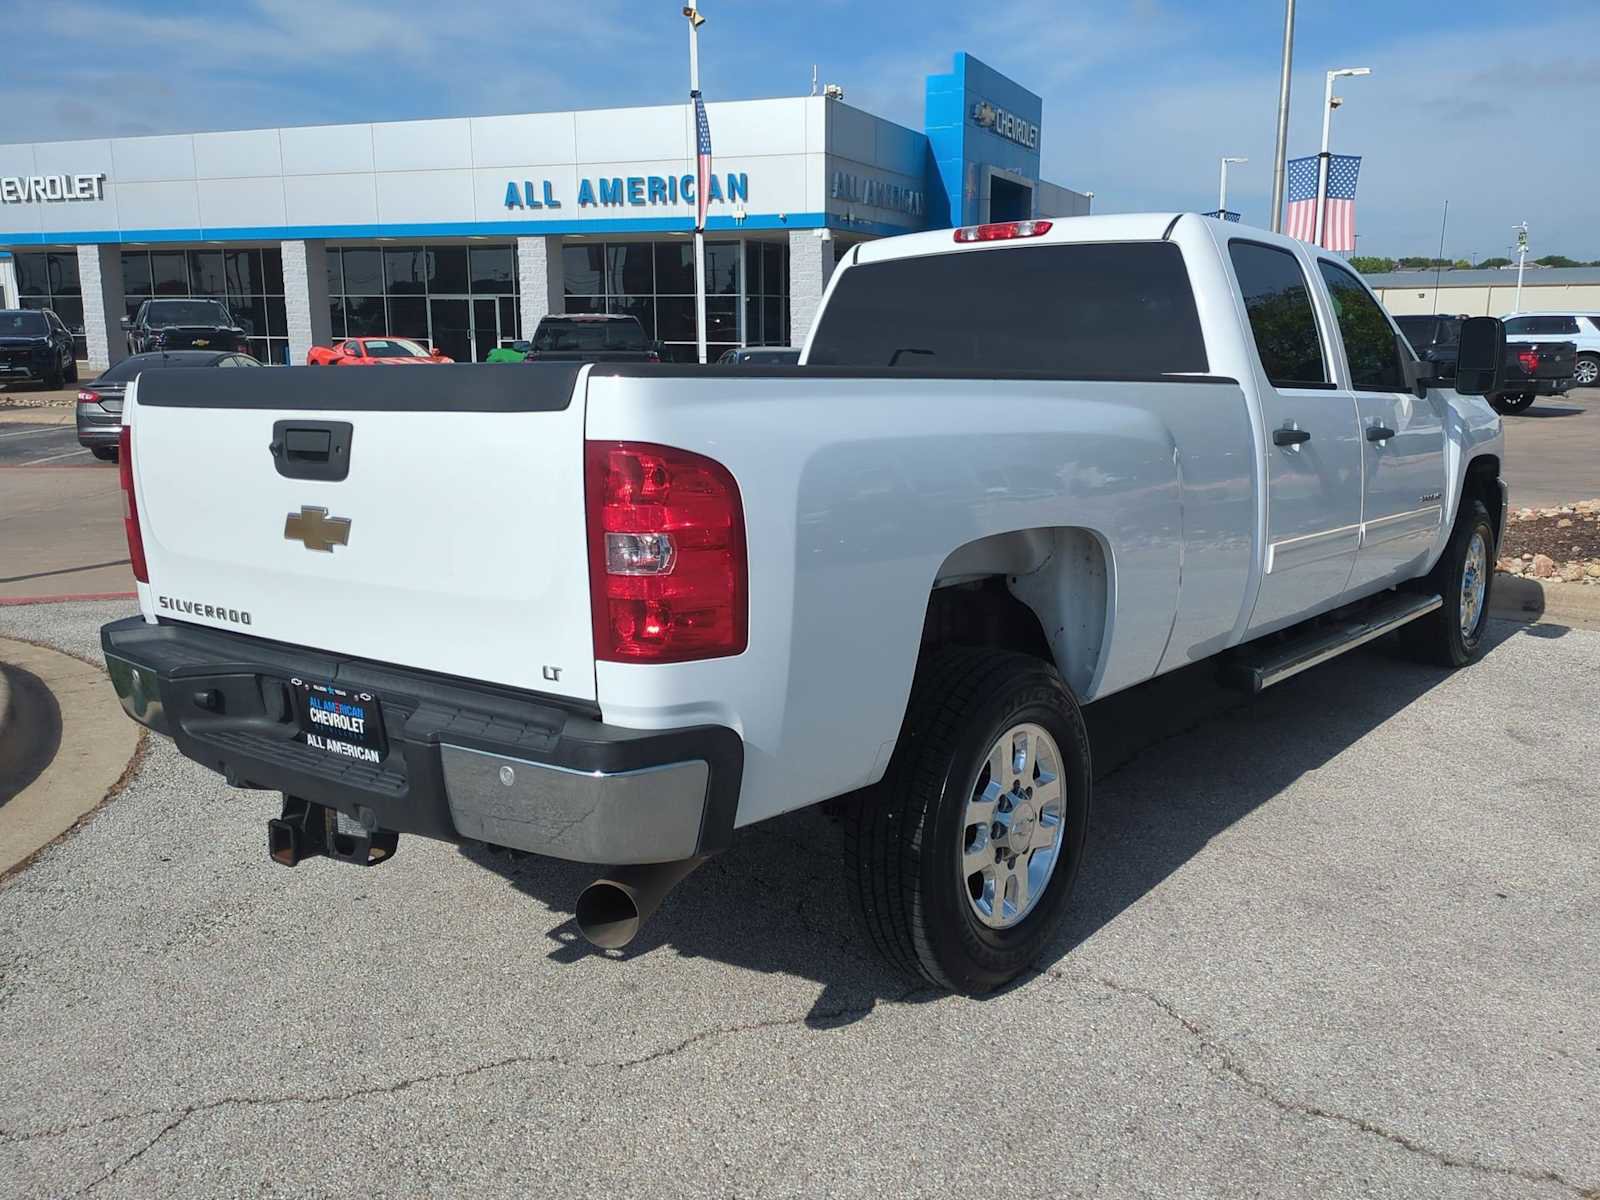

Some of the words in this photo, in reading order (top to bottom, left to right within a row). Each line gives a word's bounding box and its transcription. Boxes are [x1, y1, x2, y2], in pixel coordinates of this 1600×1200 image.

[996, 108, 1038, 149] CHEVROLET
[0, 173, 105, 203] EVROLET
[504, 180, 561, 210] ALL
[577, 173, 749, 208] AMERICAN
[159, 596, 251, 625] SILVERADO
[542, 665, 563, 682] LT
[309, 697, 322, 709] ALL
[323, 701, 364, 718] AMERICAN
[310, 707, 364, 734] CHEVROLET
[307, 734, 325, 749] ALL
[327, 739, 380, 763] AMERICAN
